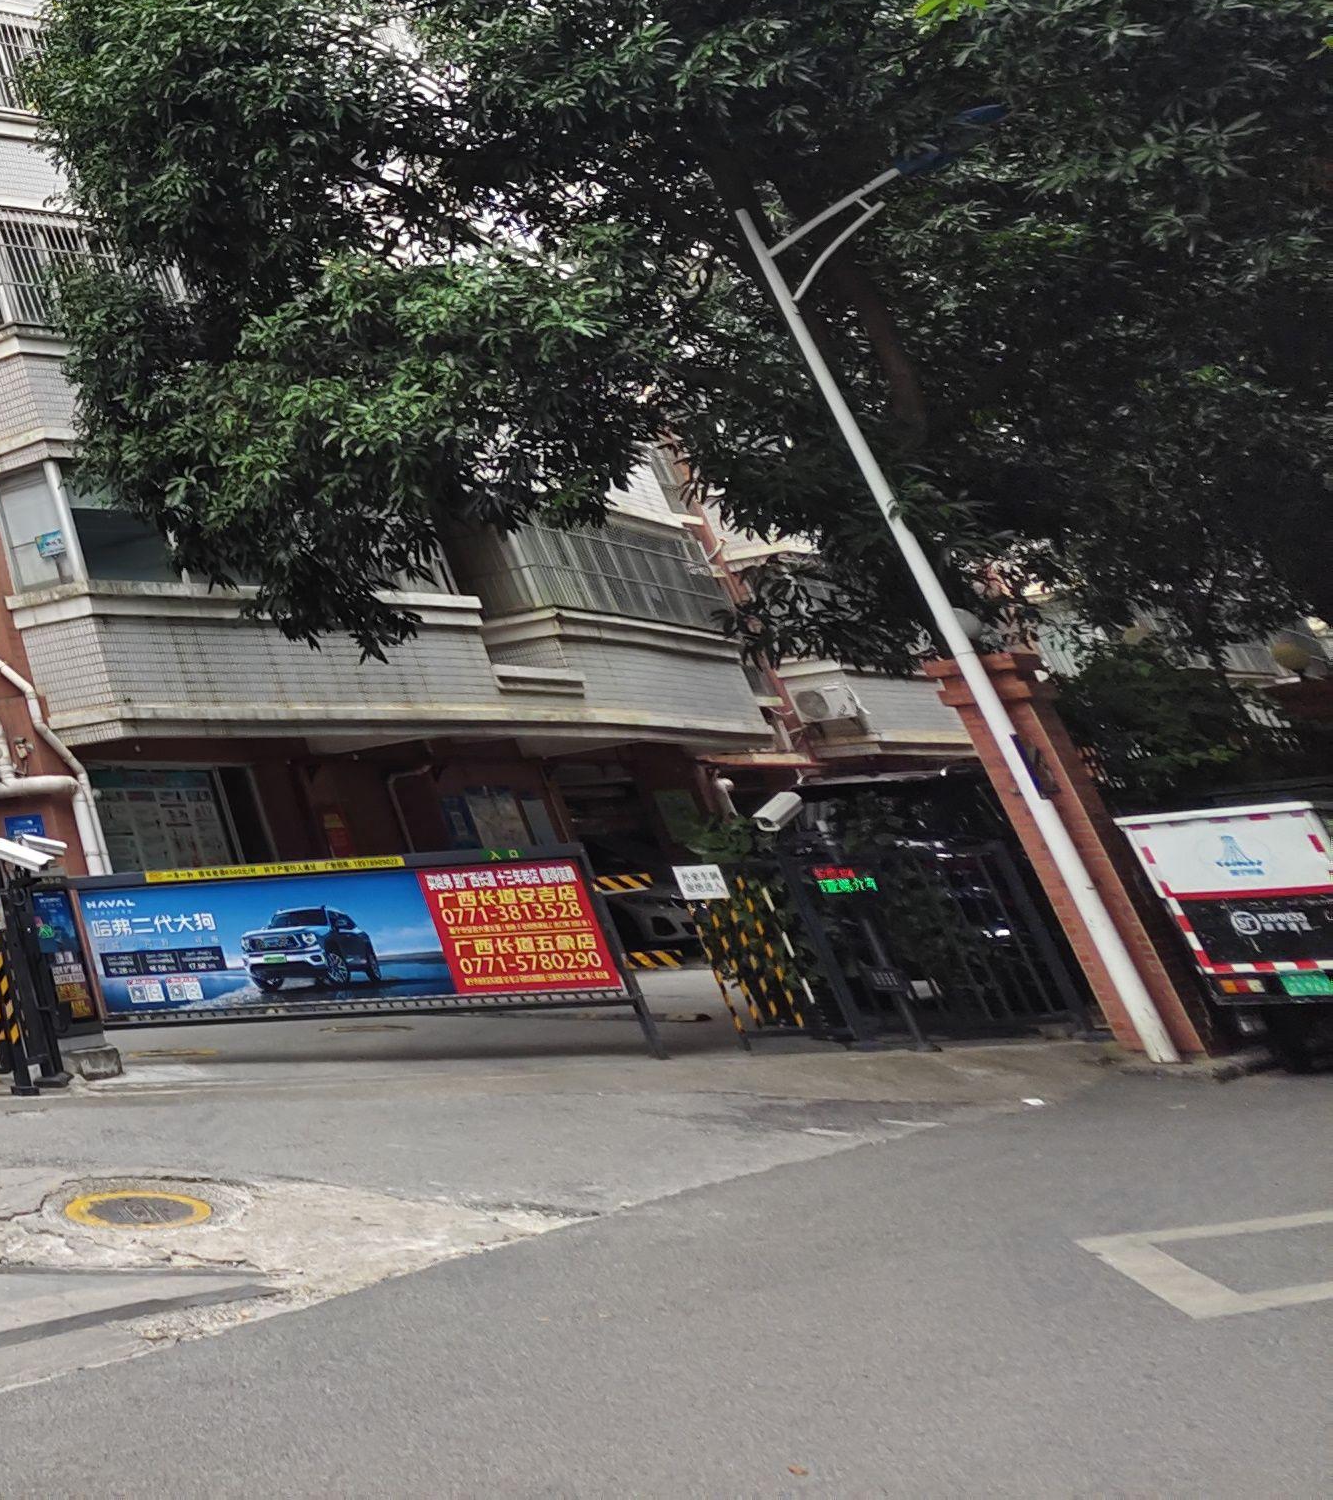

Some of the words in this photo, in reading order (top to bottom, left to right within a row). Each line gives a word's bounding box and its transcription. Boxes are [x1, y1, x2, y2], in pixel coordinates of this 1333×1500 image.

[490, 850, 520, 860] 入口
[438, 885, 578, 908] 广西长道安吉店
[91, 912, 217, 937] 哈弗二代大狗
[441, 901, 583, 925] 0771-3813528
[454, 933, 598, 956] 广西长道五象店
[459, 951, 602, 975] 0771-5780290
